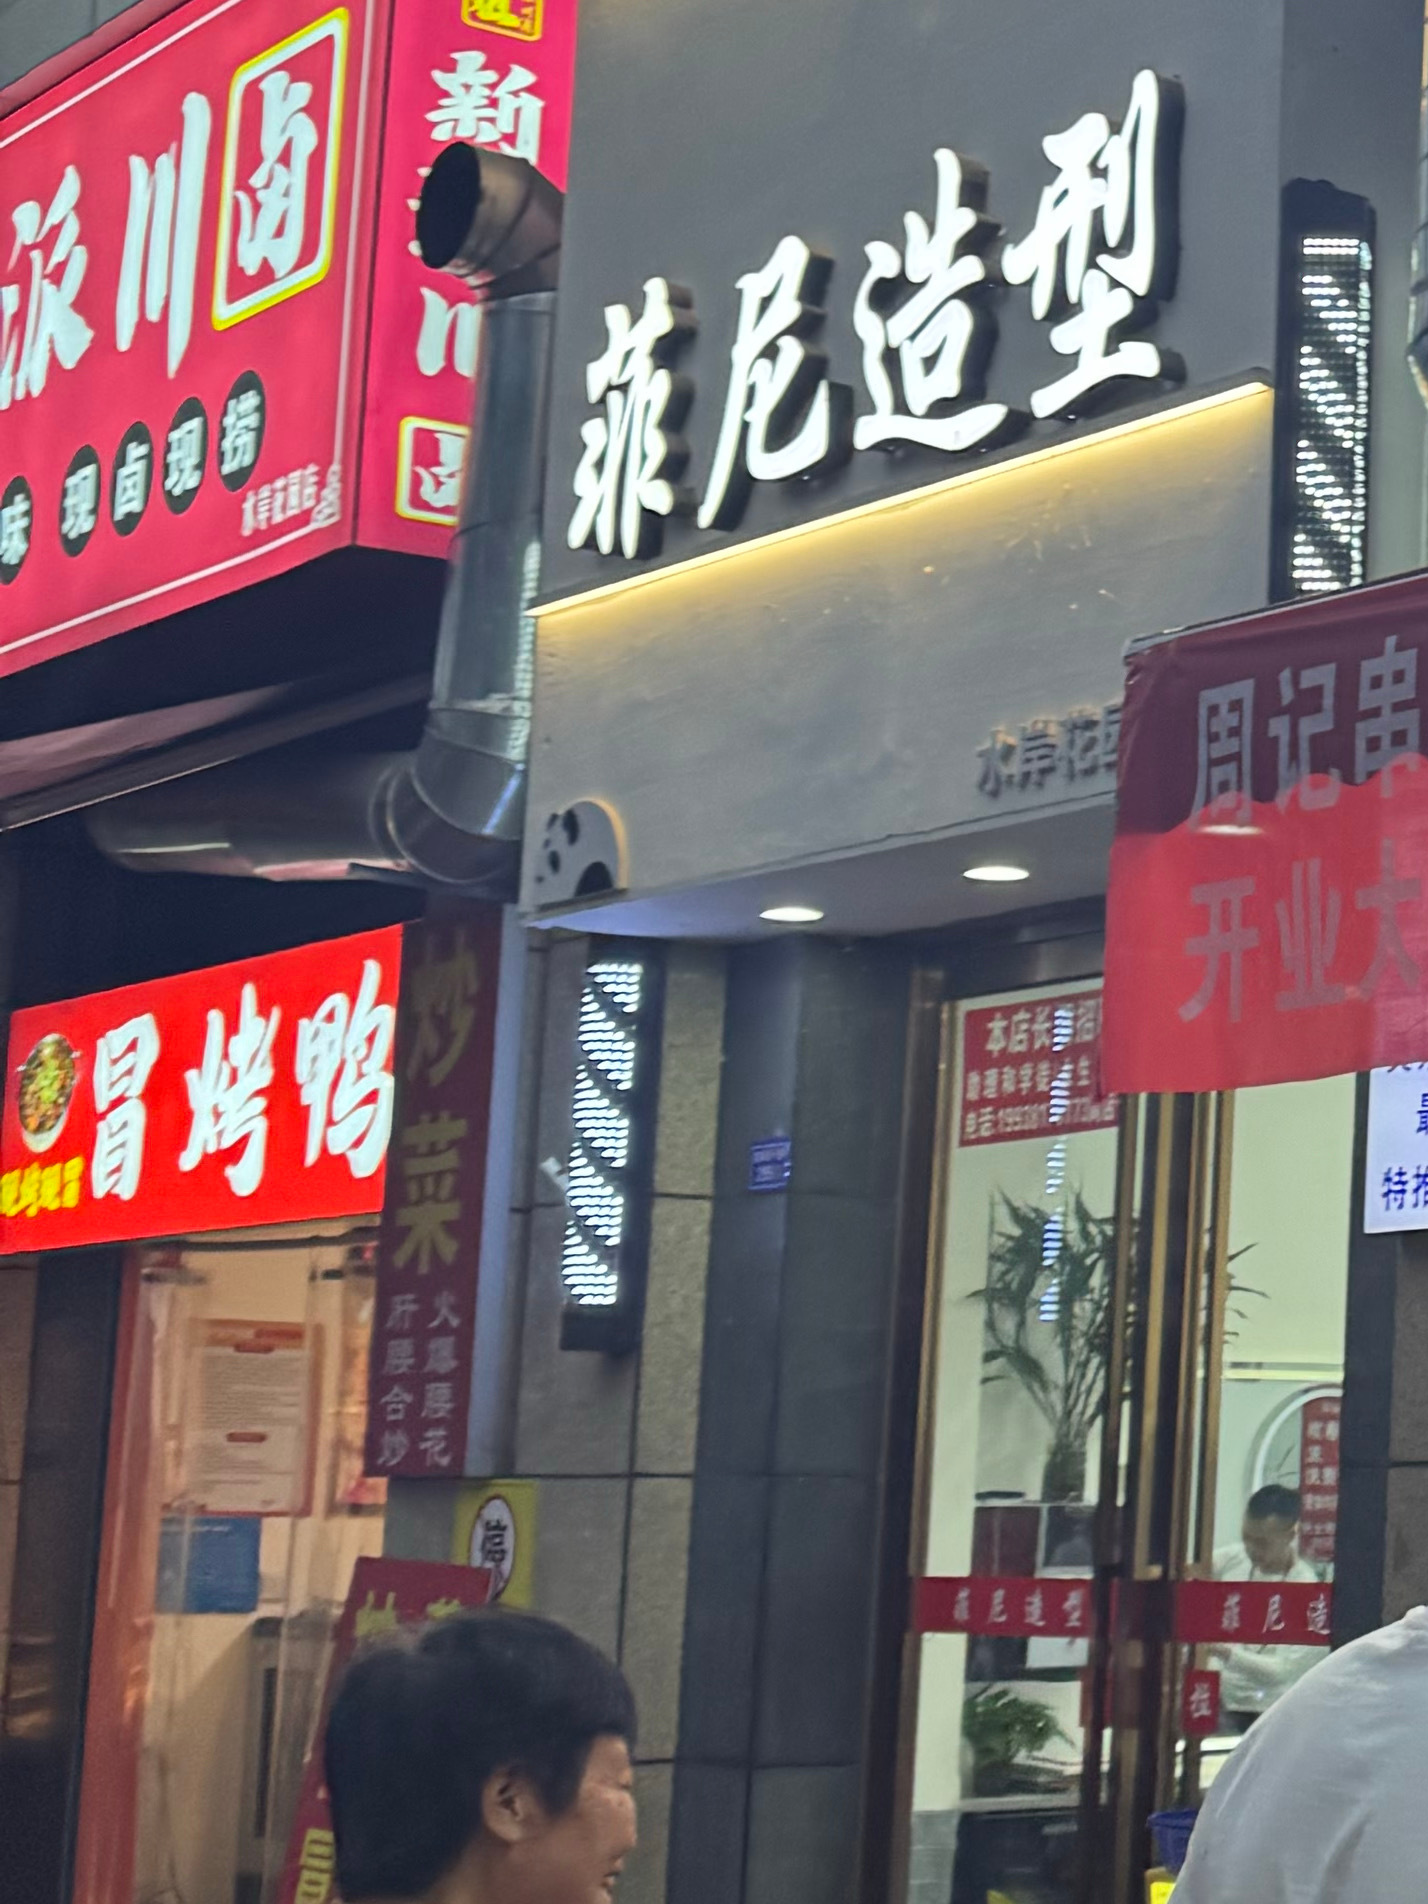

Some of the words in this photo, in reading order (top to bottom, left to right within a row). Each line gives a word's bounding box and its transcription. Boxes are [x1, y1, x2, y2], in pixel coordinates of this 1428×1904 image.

[566, 68, 1160, 560] 菲尼造型
[92, 958, 396, 1201] 冒烤鸭
[393, 924, 480, 1278] 炒菜
